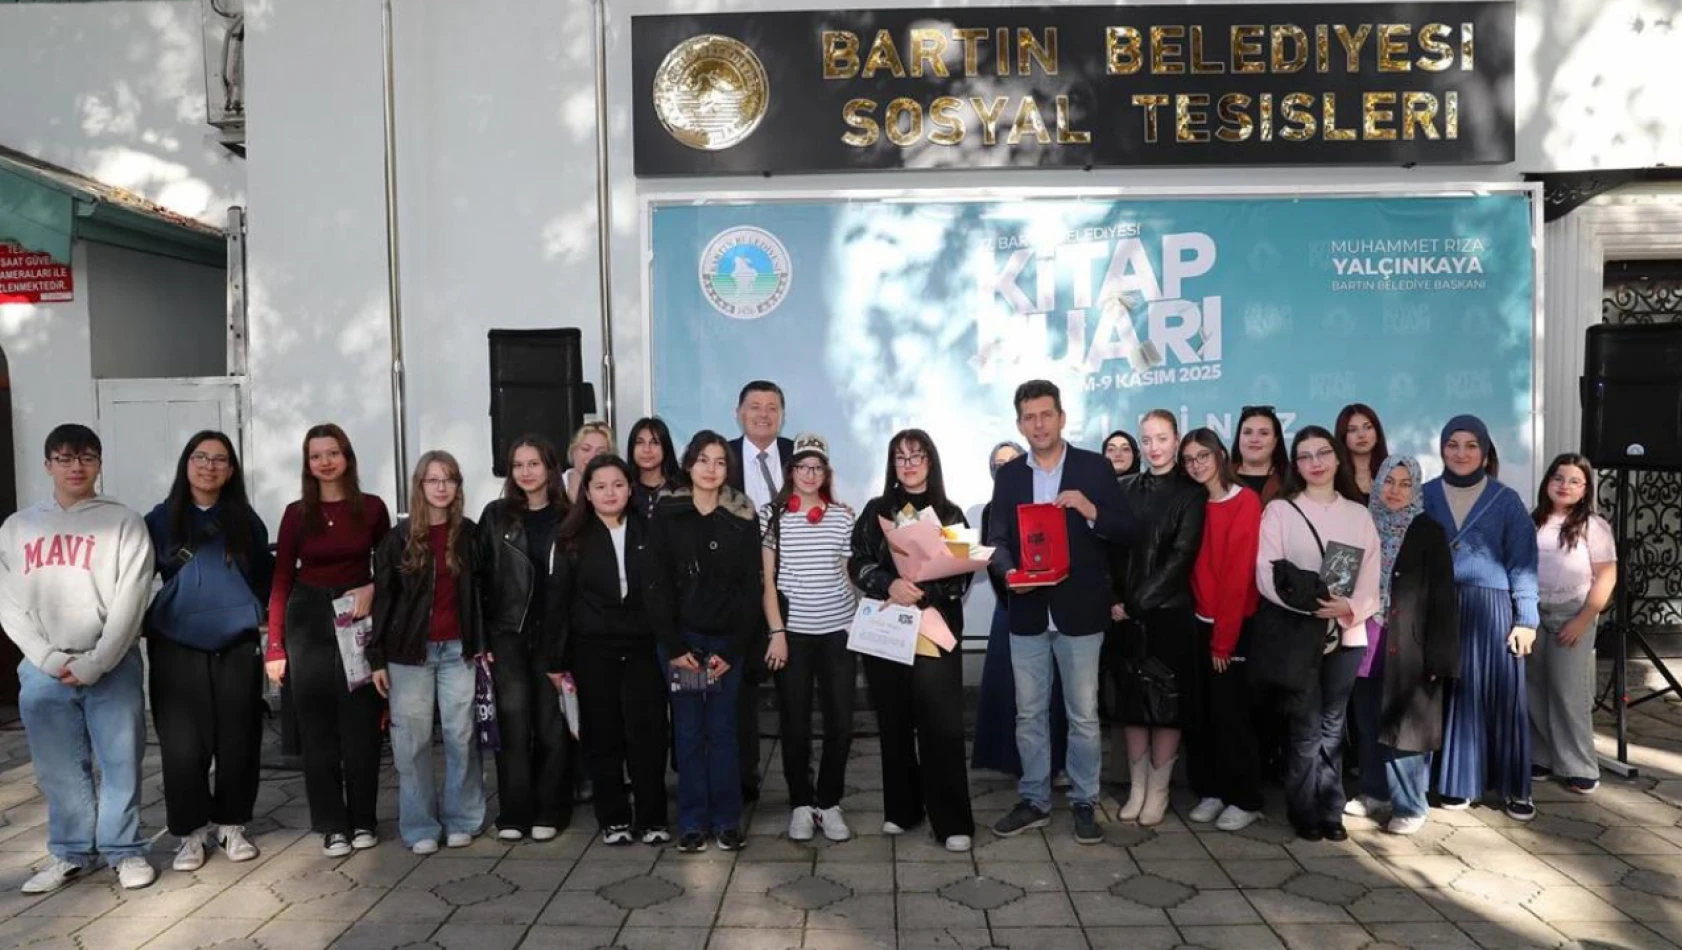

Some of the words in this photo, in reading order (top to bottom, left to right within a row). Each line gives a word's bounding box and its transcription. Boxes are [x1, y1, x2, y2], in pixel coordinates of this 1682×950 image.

[821, 27, 1058, 79] BARTIN
[1105, 22, 1474, 75] BELEDIYESI
[840, 95, 1091, 147] SOSYAL
[1131, 91, 1458, 143] TESISLERI
[1331, 239, 1440, 253] MUHAMMET
[1444, 238, 1485, 252] RIZA
[0, 269, 52, 279] AMERALARI
[978, 231, 1217, 315] KİTAP
[1332, 256, 1483, 280] YALÇINKAYA
[1332, 281, 1375, 291] BARTIN
[1377, 279, 1431, 291] BELEDİYE
[1115, 367, 1175, 389] KASIM
[1179, 364, 1223, 382] 2025
[24, 533, 96, 575] MAVİ
